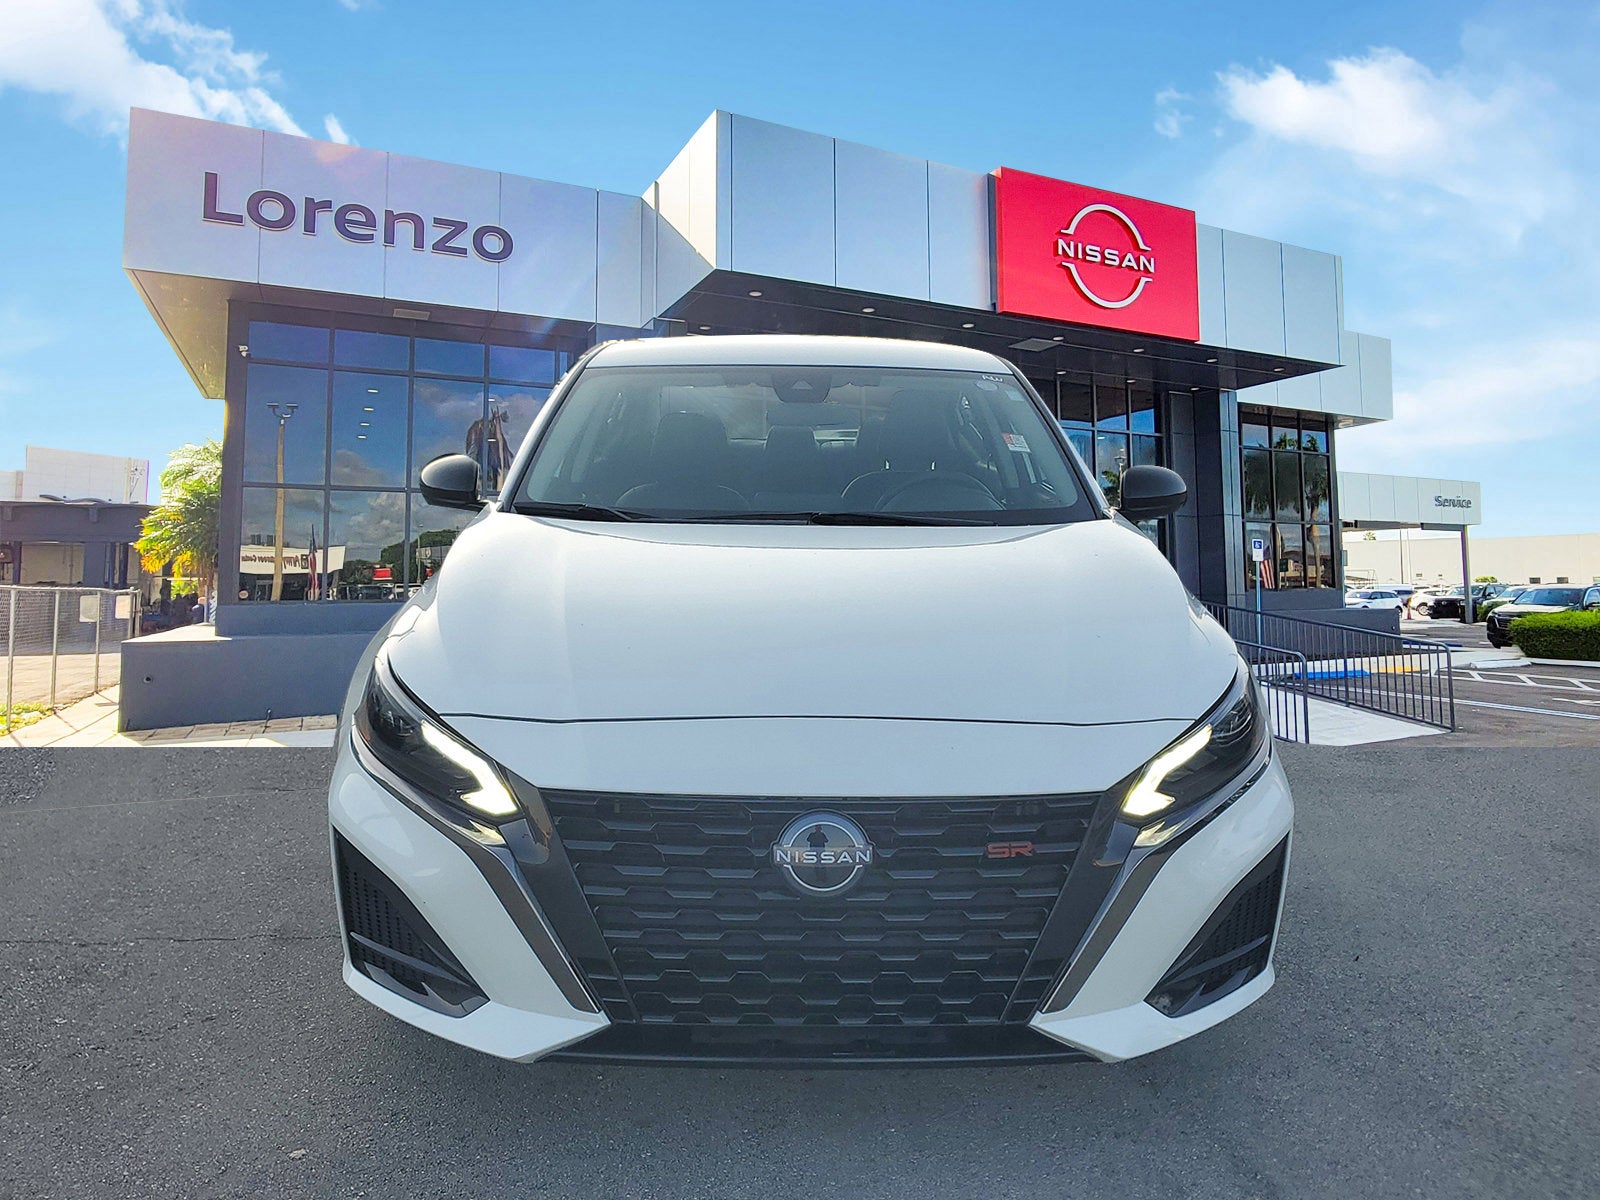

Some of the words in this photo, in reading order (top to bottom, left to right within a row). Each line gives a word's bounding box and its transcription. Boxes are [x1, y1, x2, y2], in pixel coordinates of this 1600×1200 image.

[202, 171, 514, 263] Lorenzo
[1057, 238, 1155, 273] NISSAN
[1434, 495, 1472, 508] Service
[776, 850, 870, 864] NISSAN
[987, 841, 1033, 858] SR
